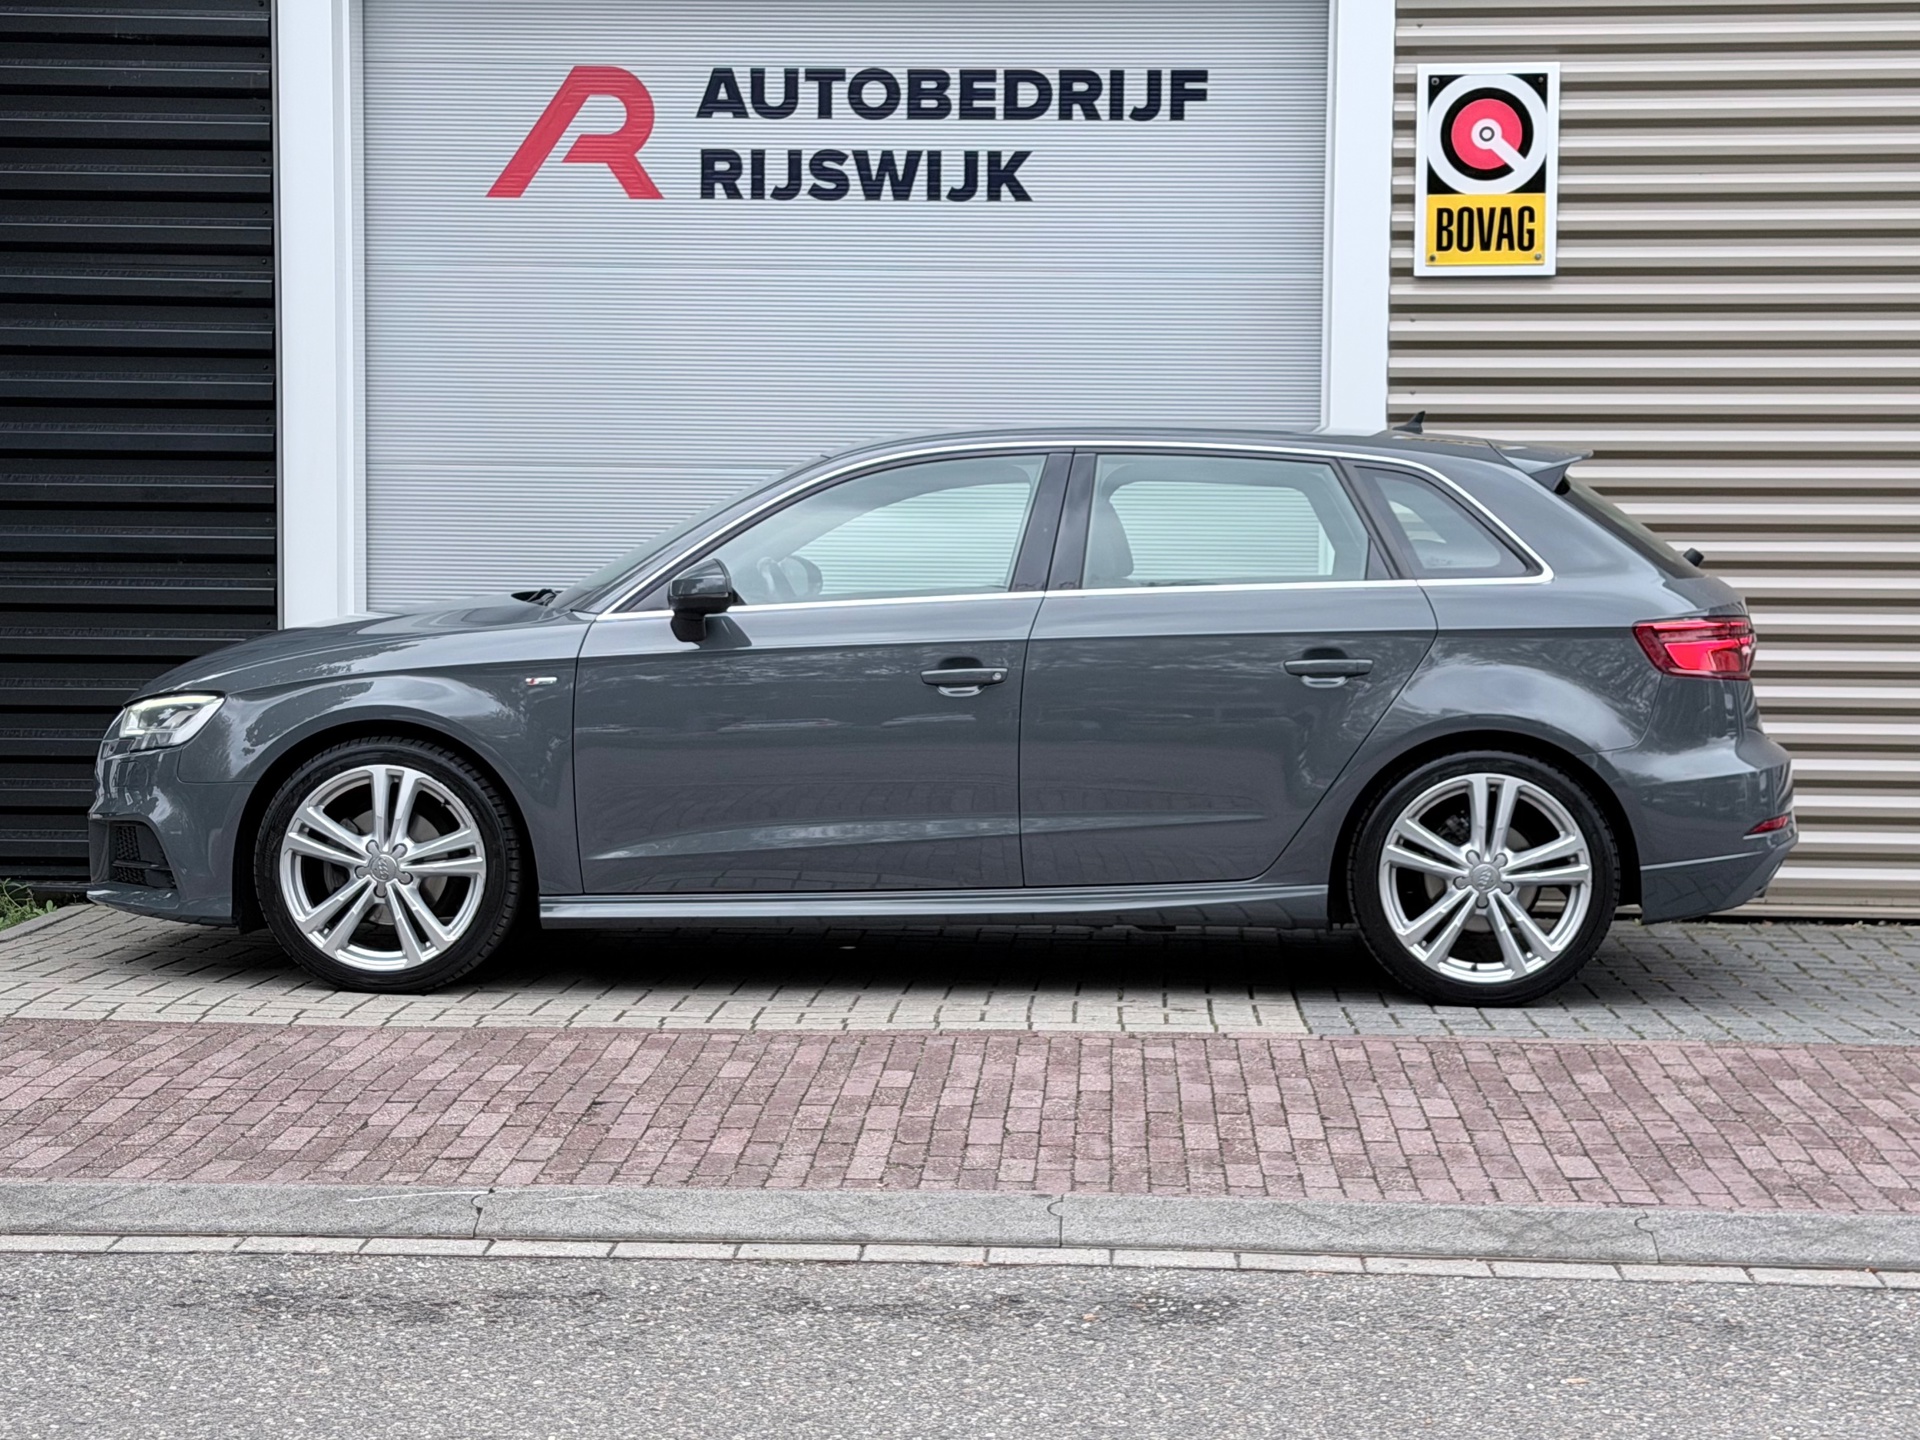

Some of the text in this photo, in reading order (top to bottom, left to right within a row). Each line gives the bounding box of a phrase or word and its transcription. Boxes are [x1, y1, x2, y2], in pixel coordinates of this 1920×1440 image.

[696, 67, 1208, 121] AUTOBEDRIJF
[700, 148, 1033, 202] RIJSWIJK
[1436, 205, 1536, 252] BOVAG
